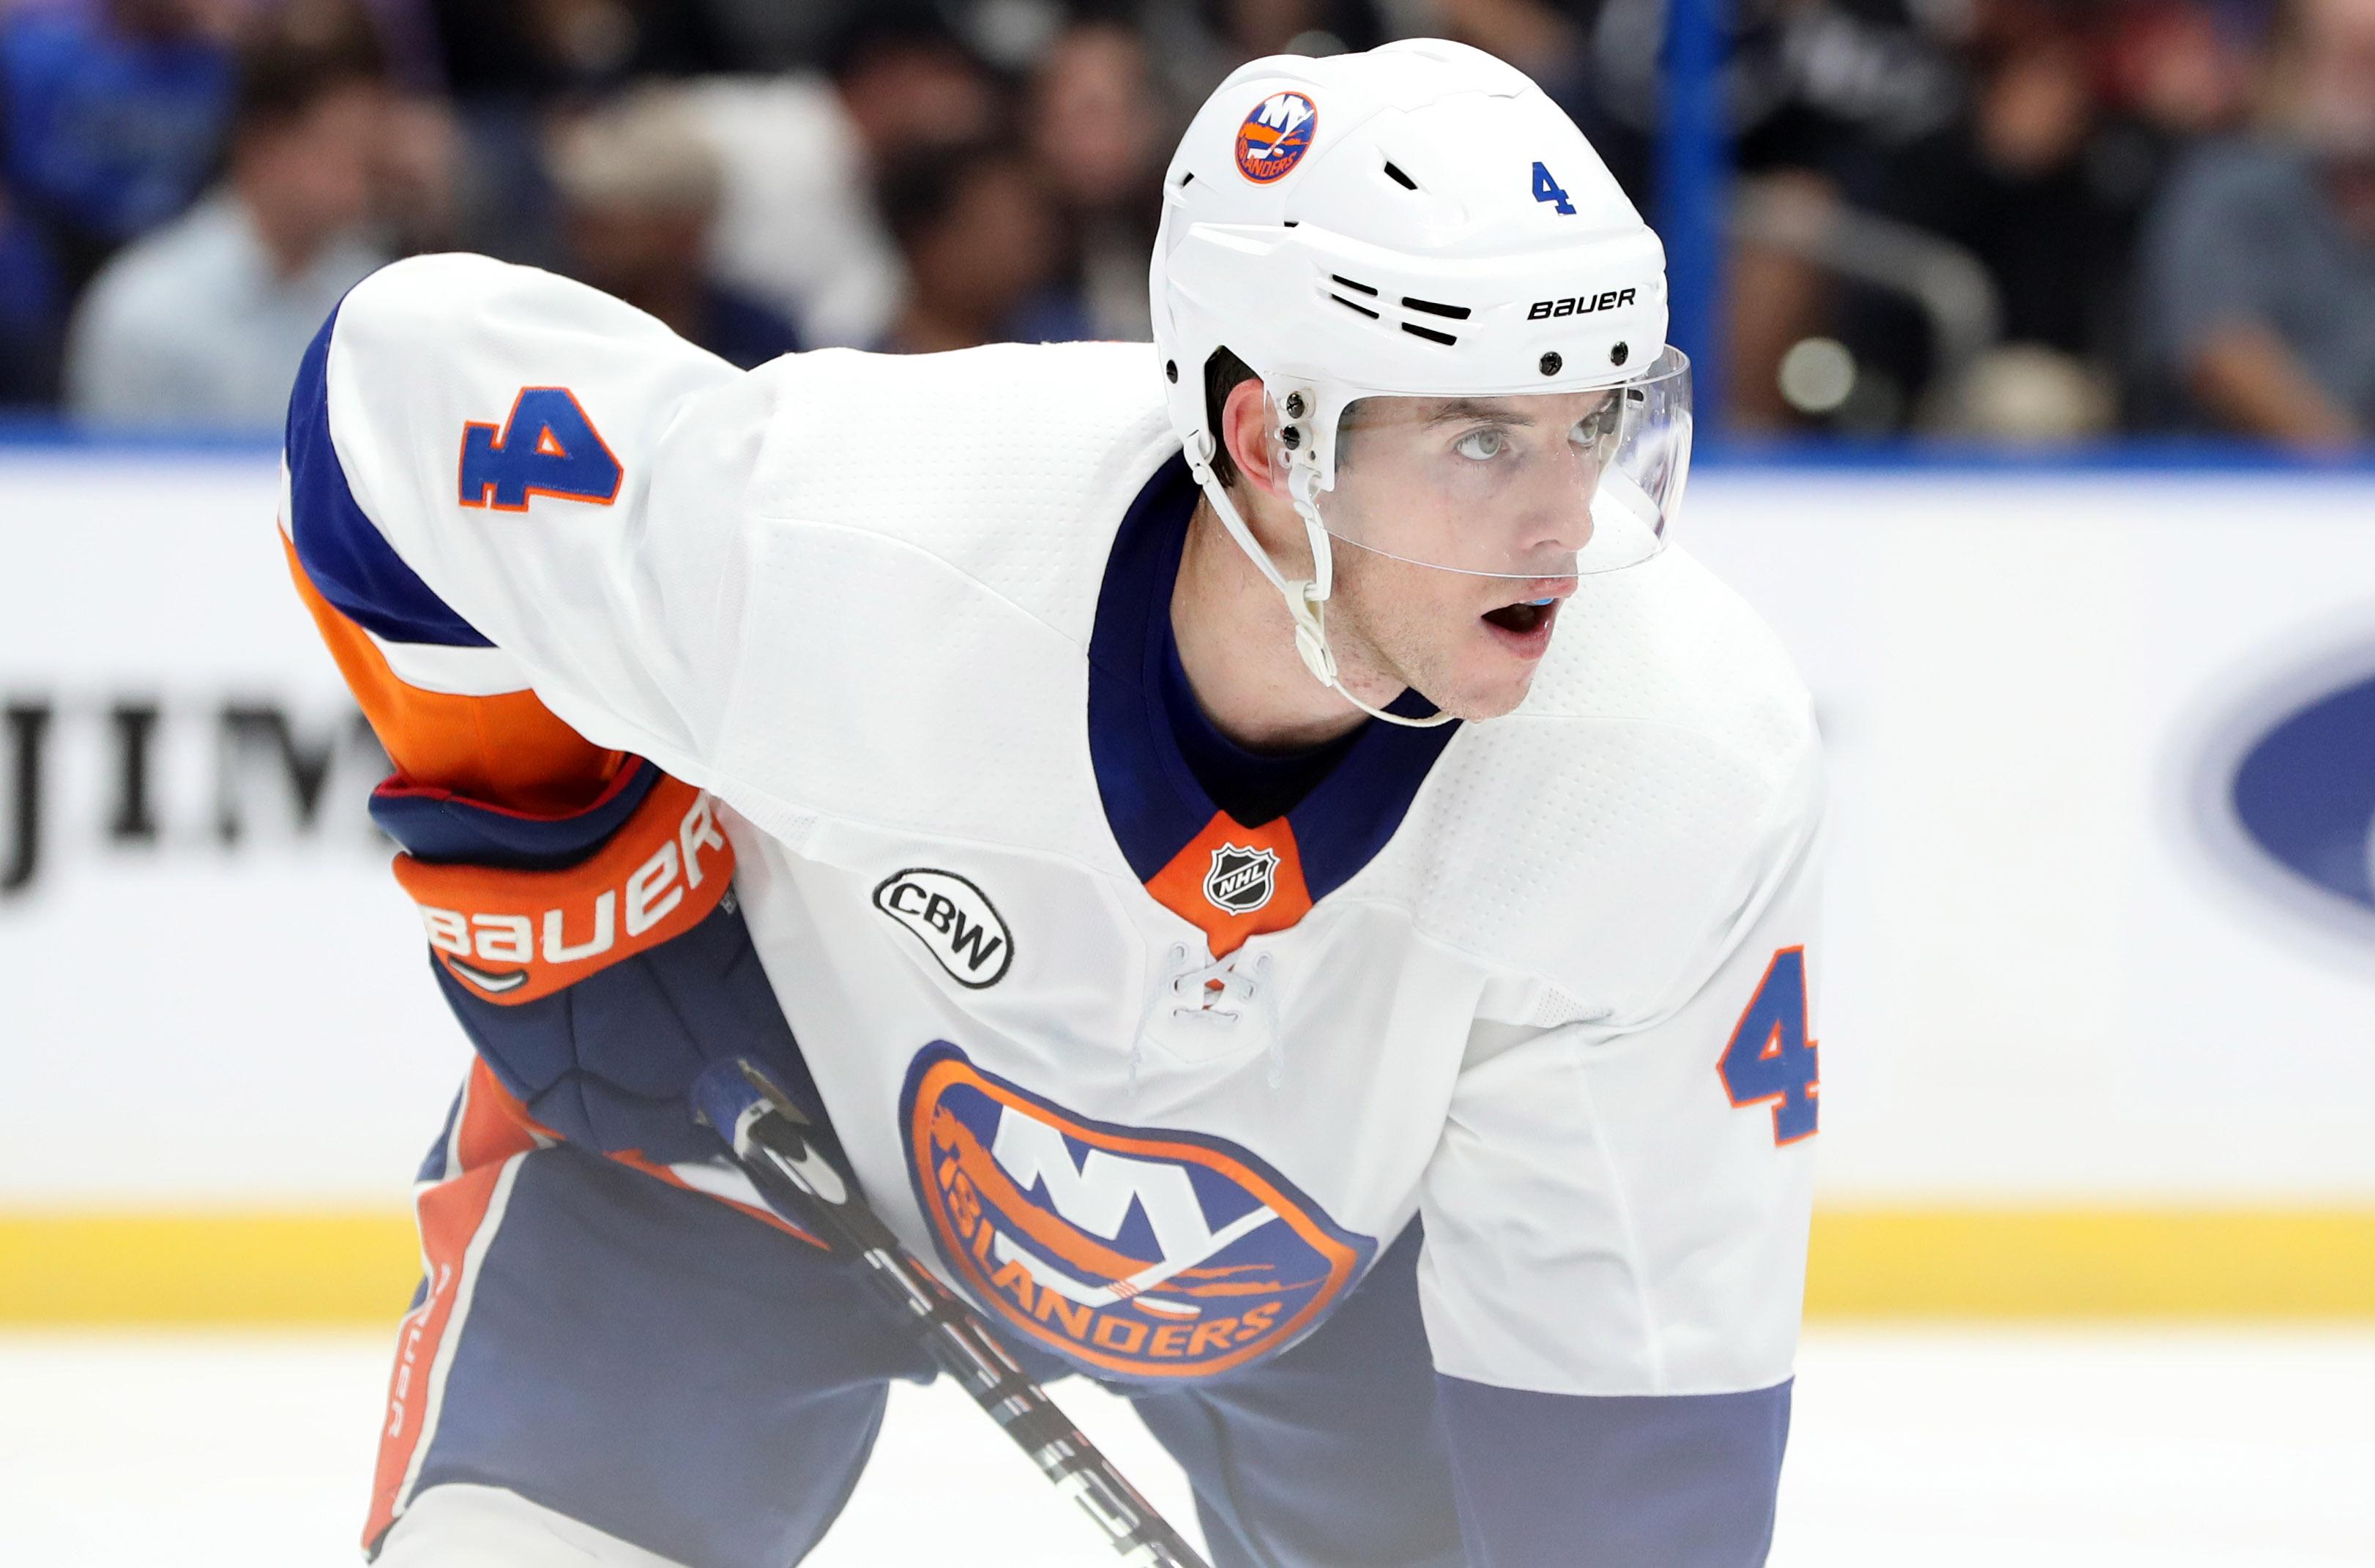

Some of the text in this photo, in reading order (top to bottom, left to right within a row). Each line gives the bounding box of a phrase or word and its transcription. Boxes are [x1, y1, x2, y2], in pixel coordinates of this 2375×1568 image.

[1532, 162, 1577, 215] 4
[1527, 288, 1636, 321] BAUER
[458, 386, 624, 513] 4
[419, 788, 725, 965] BAUER
[888, 881, 1004, 972] CBW
[1218, 864, 1264, 897] NHL
[1715, 944, 1819, 1148] 4
[991, 1103, 1215, 1265] NY
[938, 1155, 1283, 1358] ISLANDERS
